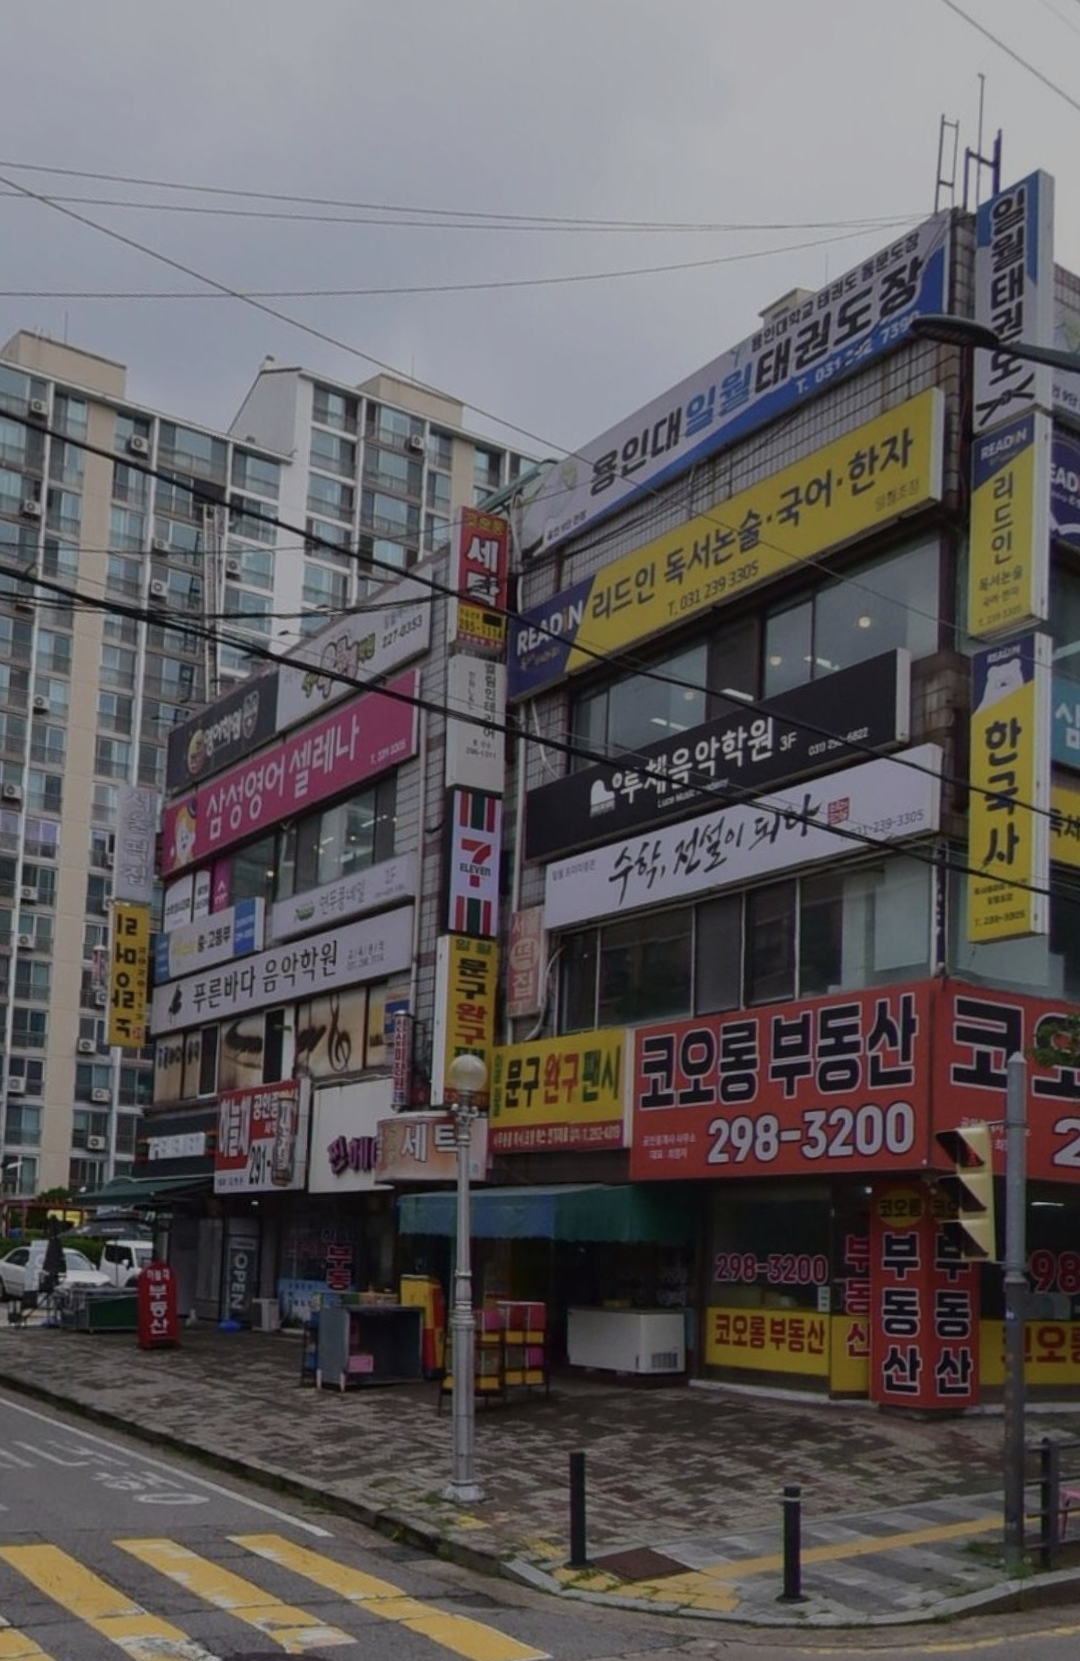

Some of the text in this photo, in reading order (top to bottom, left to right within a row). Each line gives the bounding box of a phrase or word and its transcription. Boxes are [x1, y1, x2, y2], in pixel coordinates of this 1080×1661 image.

[980, 426, 1028, 461] READIN
[990, 470, 1015, 566] 리드인
[592, 562, 656, 620] 리드인
[680, 588, 703, 610] 031
[705, 576, 727, 600] 239
[728, 562, 759, 591] 3305
[779, 731, 798, 752] 3F
[206, 753, 286, 841] 삼성영어
[983, 717, 1022, 867] 한국사
[192, 965, 257, 1014] 푸른바다
[262, 939, 338, 994] 음악학원
[505, 1056, 540, 1109] 문구
[543, 1051, 580, 1105] 완구
[638, 991, 918, 1112] 코오롱 부동산
[705, 1101, 916, 1166] 298-3200
[930, 1197, 959, 1220] 코오
[229, 1252, 248, 1311] OPEN
[714, 1252, 830, 1287] 298-3200
[148, 1283, 171, 1336] 부동산
[714, 1314, 825, 1356] 코오롱 부동산
[882, 1231, 923, 1397] 부동산
[933, 1231, 975, 1398] 부동산
